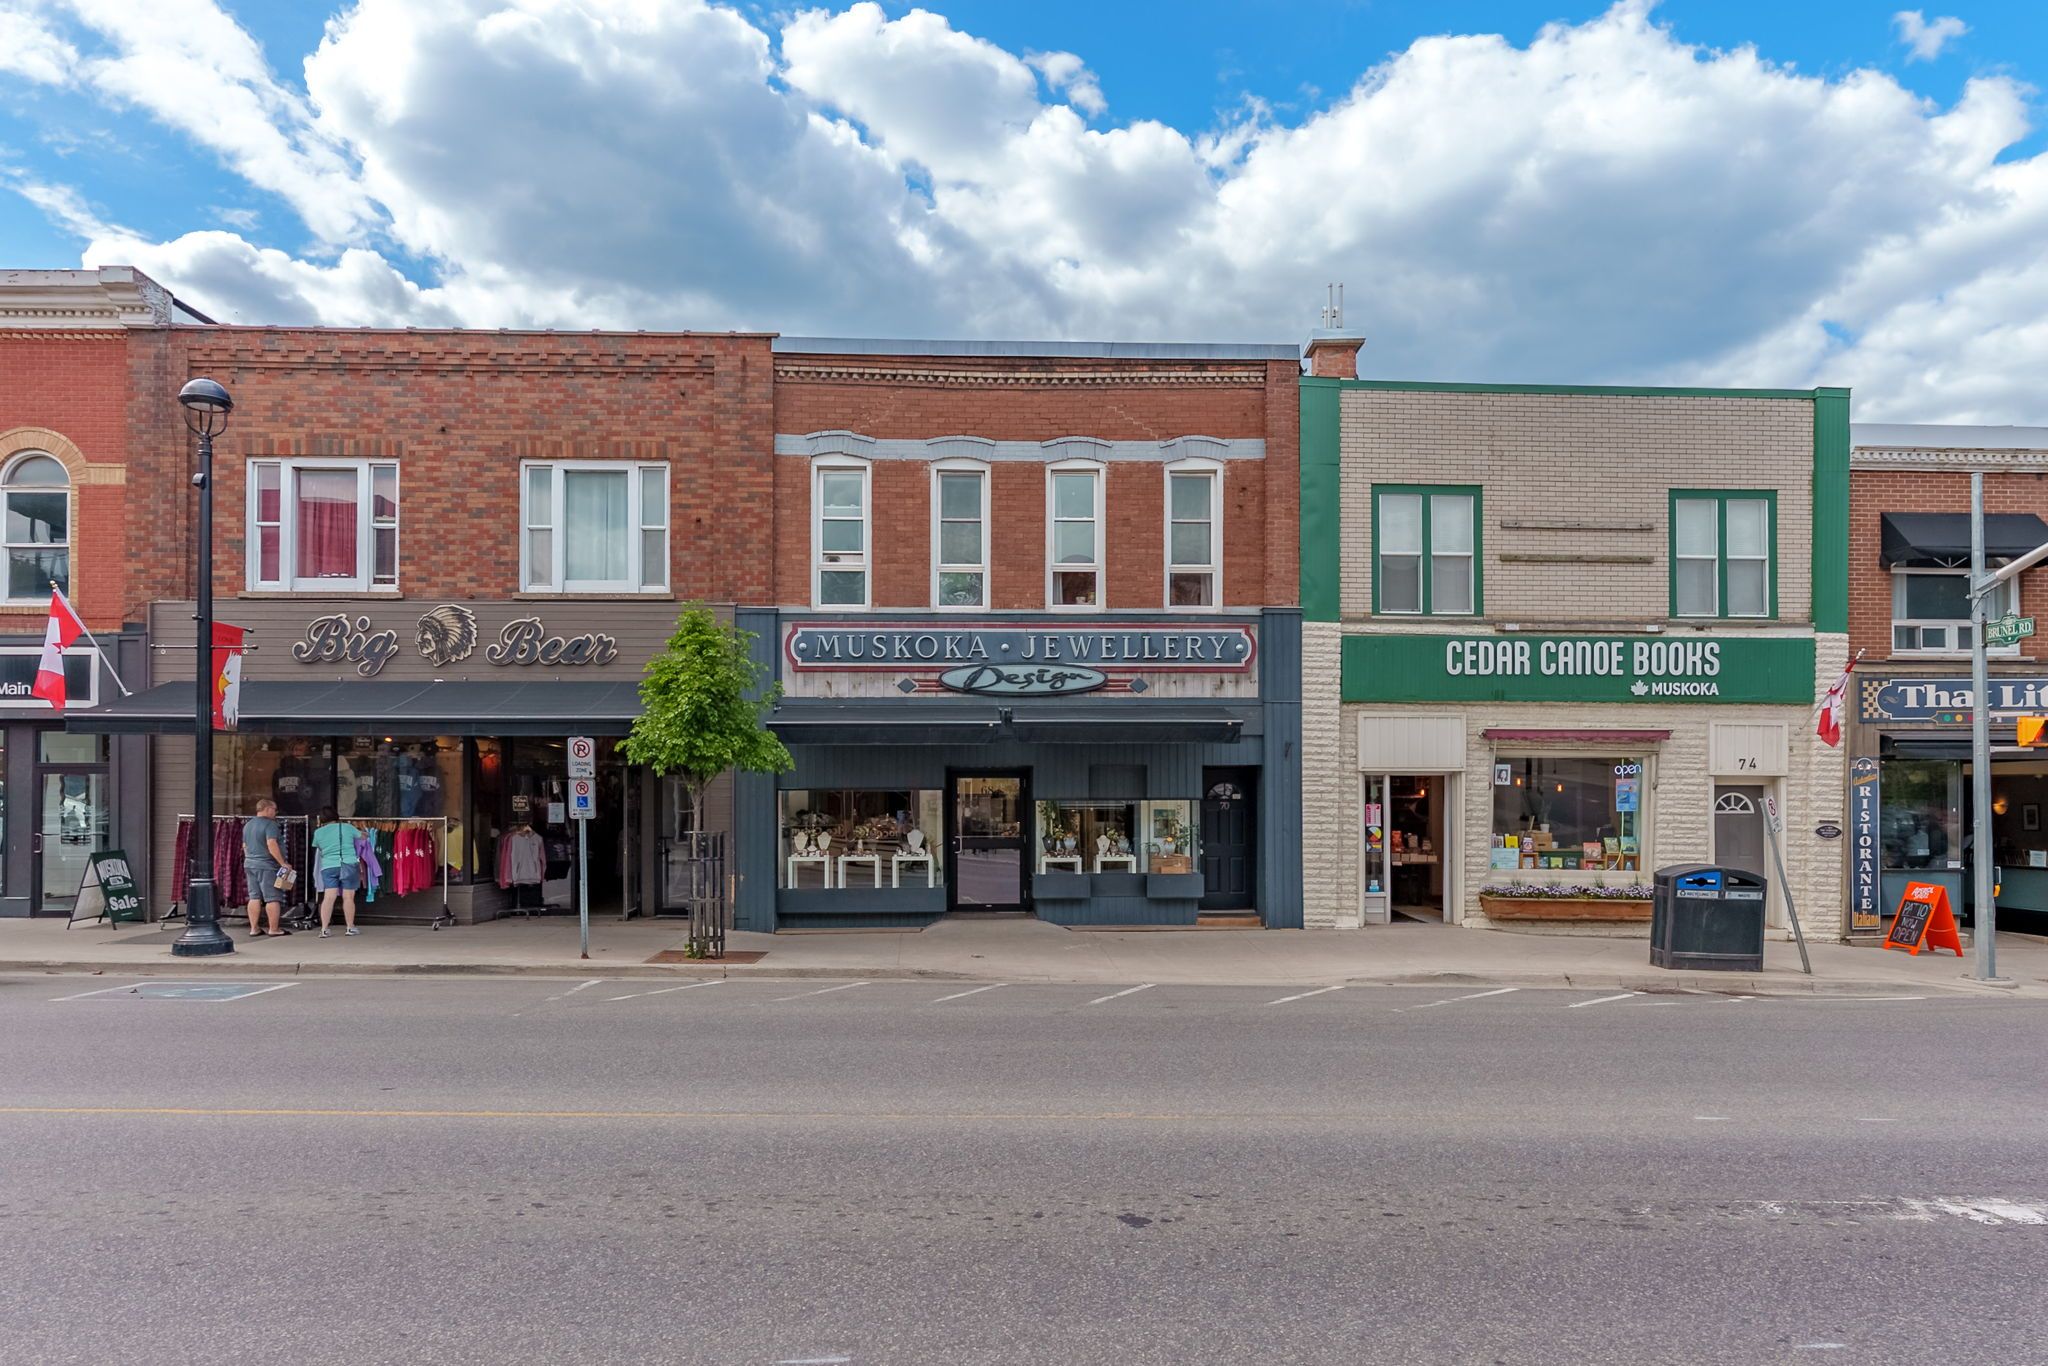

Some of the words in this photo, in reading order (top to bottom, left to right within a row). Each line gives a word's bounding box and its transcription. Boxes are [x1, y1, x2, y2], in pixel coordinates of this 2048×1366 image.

[1988, 623, 2017, 638] BRUNEL
[292, 613, 398, 677] Big
[486, 616, 617, 665] Bear
[814, 634, 989, 659] MUSKOKA
[1021, 635, 1229, 659] JEWELLERY
[1446, 640, 1530, 675] CEDAR
[1540, 641, 1624, 675] CANOE
[1633, 641, 1720, 676] BOOKS
[963, 661, 1093, 690] Design
[1651, 682, 1719, 696] MUSKOKA
[1898, 684, 1992, 708] Tha
[1614, 764, 1642, 778] open
[1739, 757, 1757, 770] 74
[1219, 801, 1230, 810] 70
[1859, 786, 1873, 910] RISTORANTE
[109, 894, 138, 911] Sale
[1902, 901, 1929, 917] PATIO
[1892, 926, 1918, 942] OPEN
